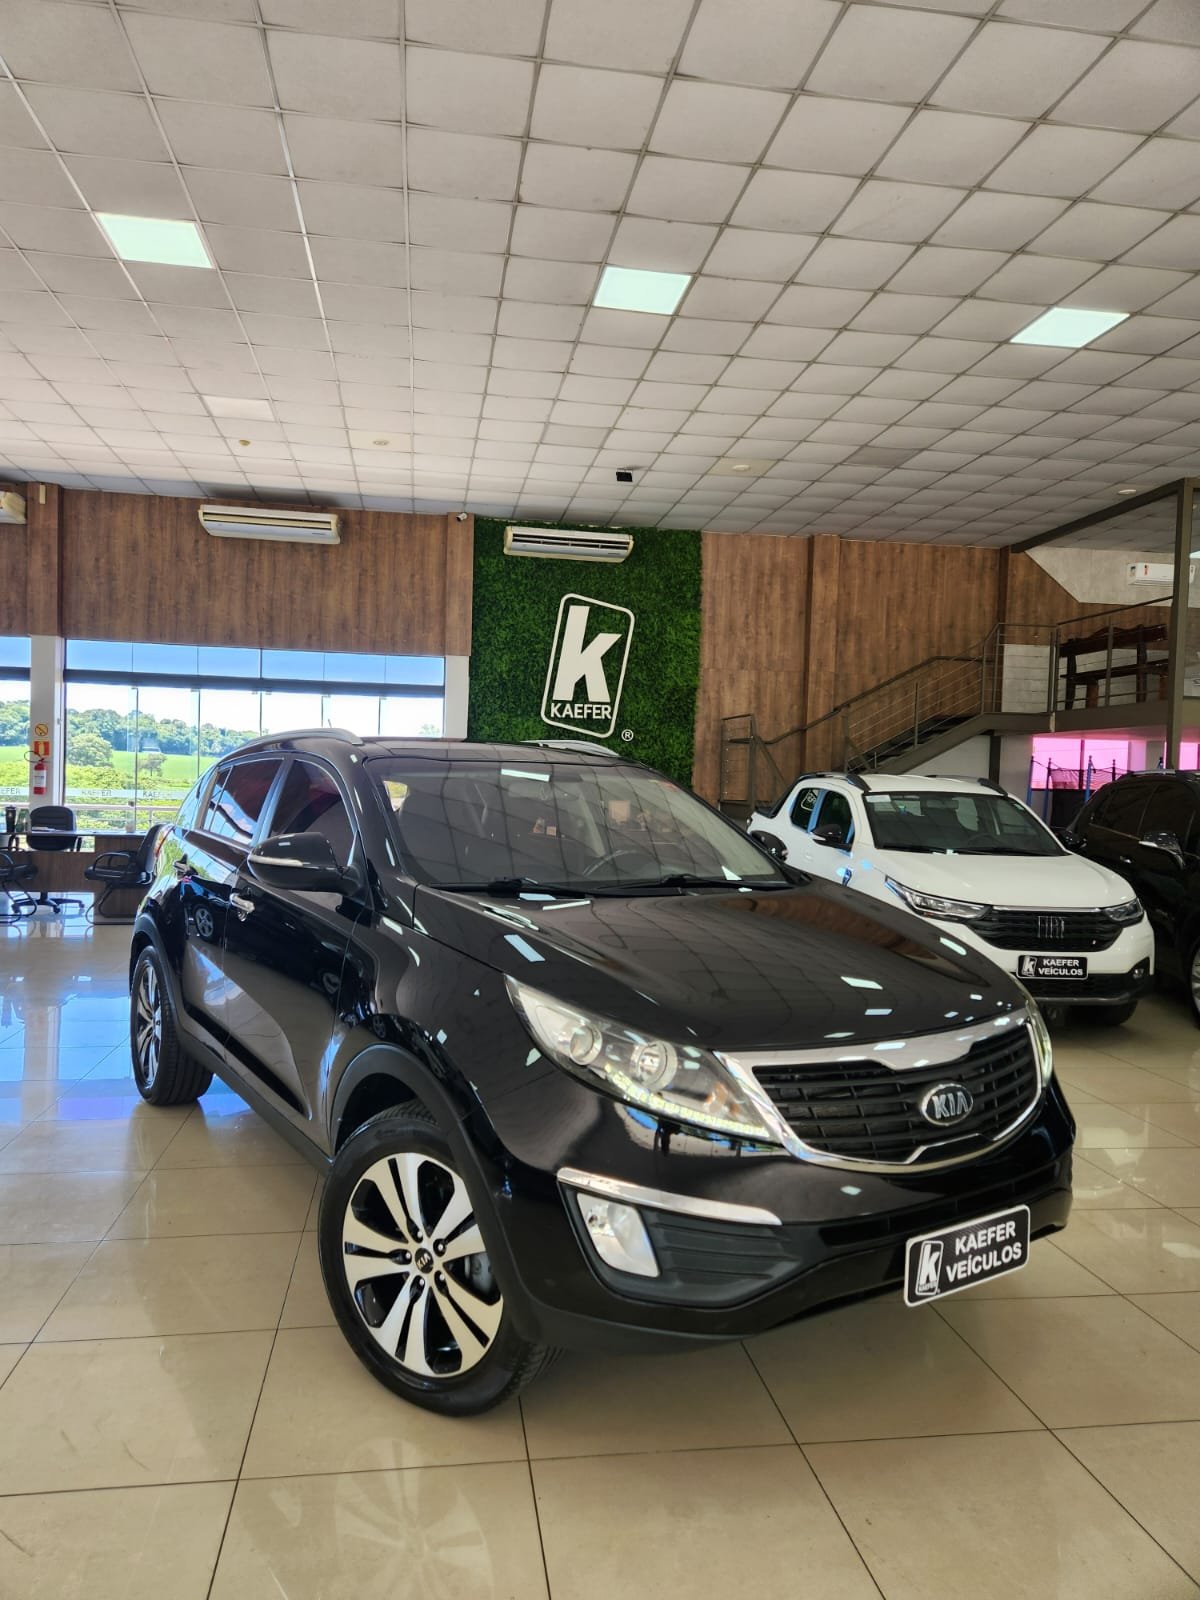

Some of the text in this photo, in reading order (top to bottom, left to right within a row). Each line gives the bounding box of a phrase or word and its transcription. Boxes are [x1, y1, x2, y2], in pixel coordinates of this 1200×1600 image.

[550, 702, 612, 720] KAEFER
[1038, 966, 1083, 976] VEÍCULOS
[1043, 959, 1079, 967] KAEFER
[932, 1091, 969, 1119] KIA
[955, 1221, 1016, 1256] KAEFER
[416, 1253, 431, 1269] KIA
[946, 1241, 1022, 1283] VEÍCULOS
